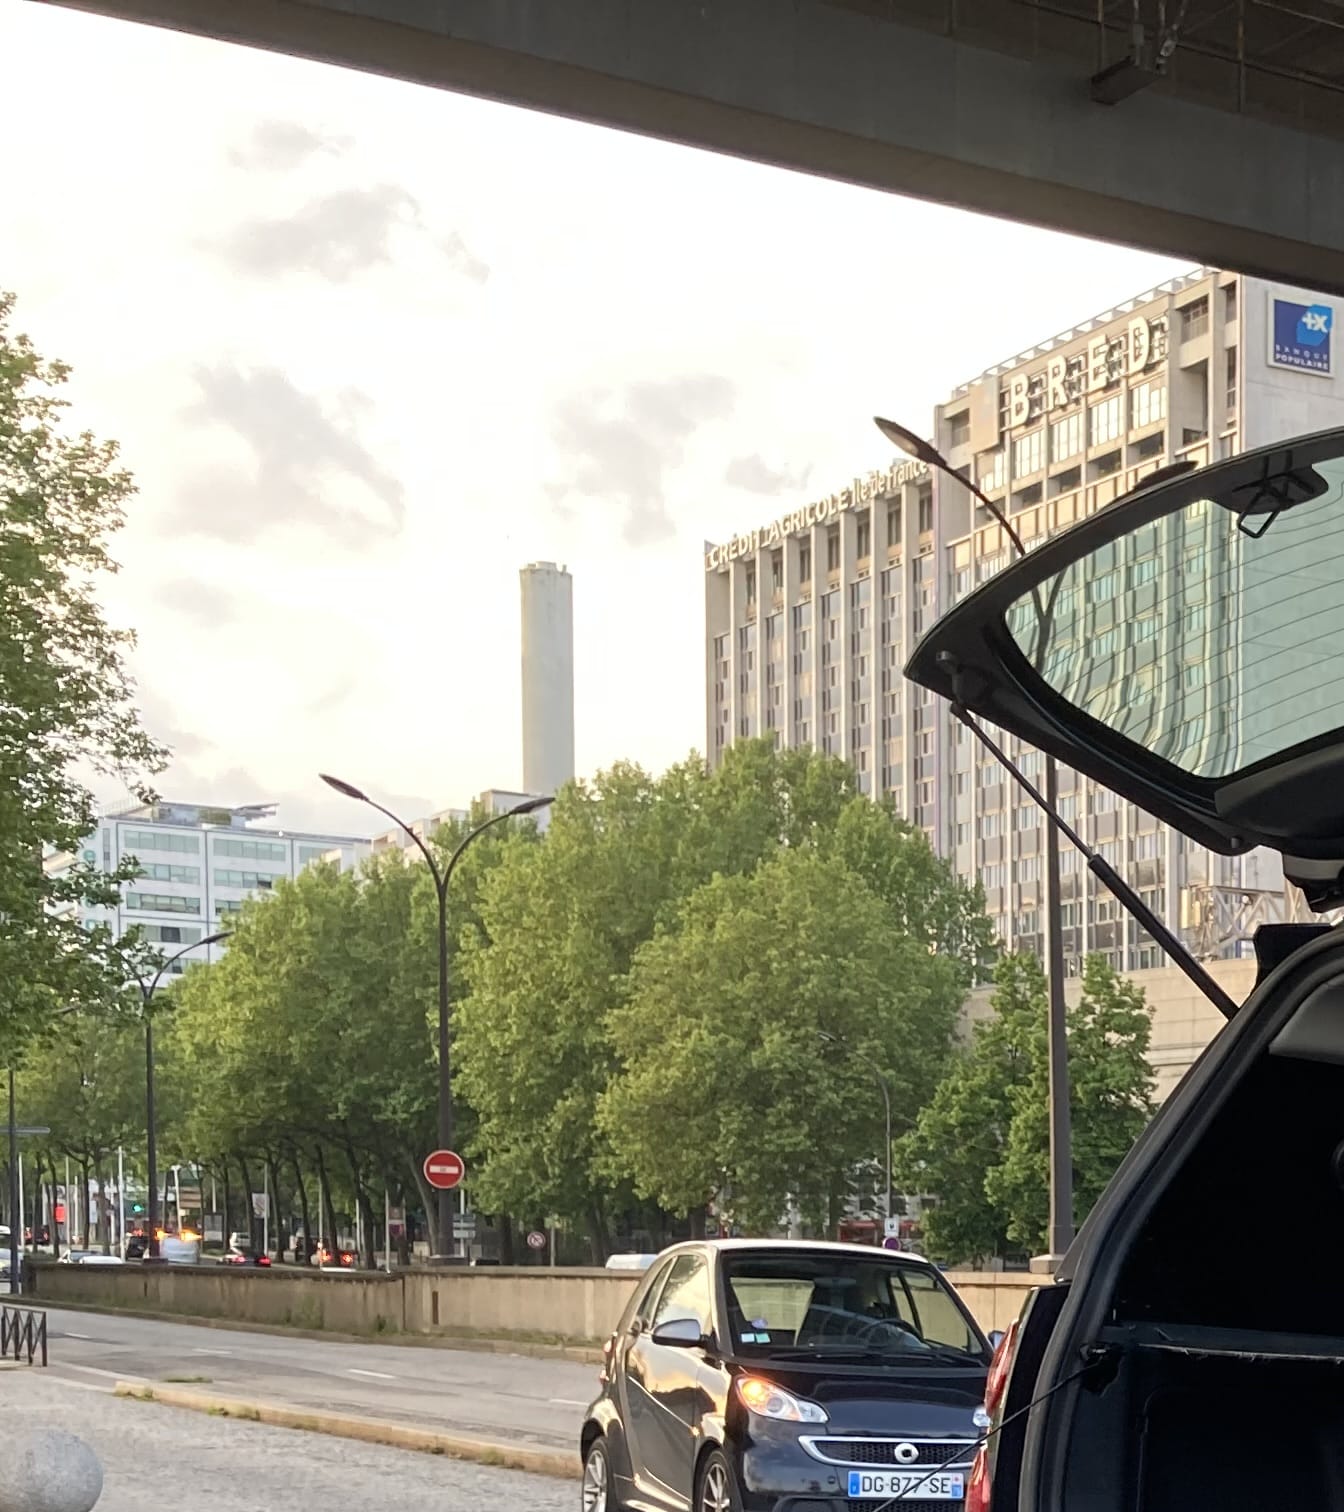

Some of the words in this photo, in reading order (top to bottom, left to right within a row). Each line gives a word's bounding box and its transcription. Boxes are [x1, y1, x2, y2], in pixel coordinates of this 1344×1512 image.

[1275, 343, 1328, 359] BANQUE
[1275, 353, 1329, 370] POPULAIRE
[1009, 315, 1150, 430] BRED
[768, 488, 849, 543] AGRICOLE
[862, 1476, 951, 1494] DG-877-SE
